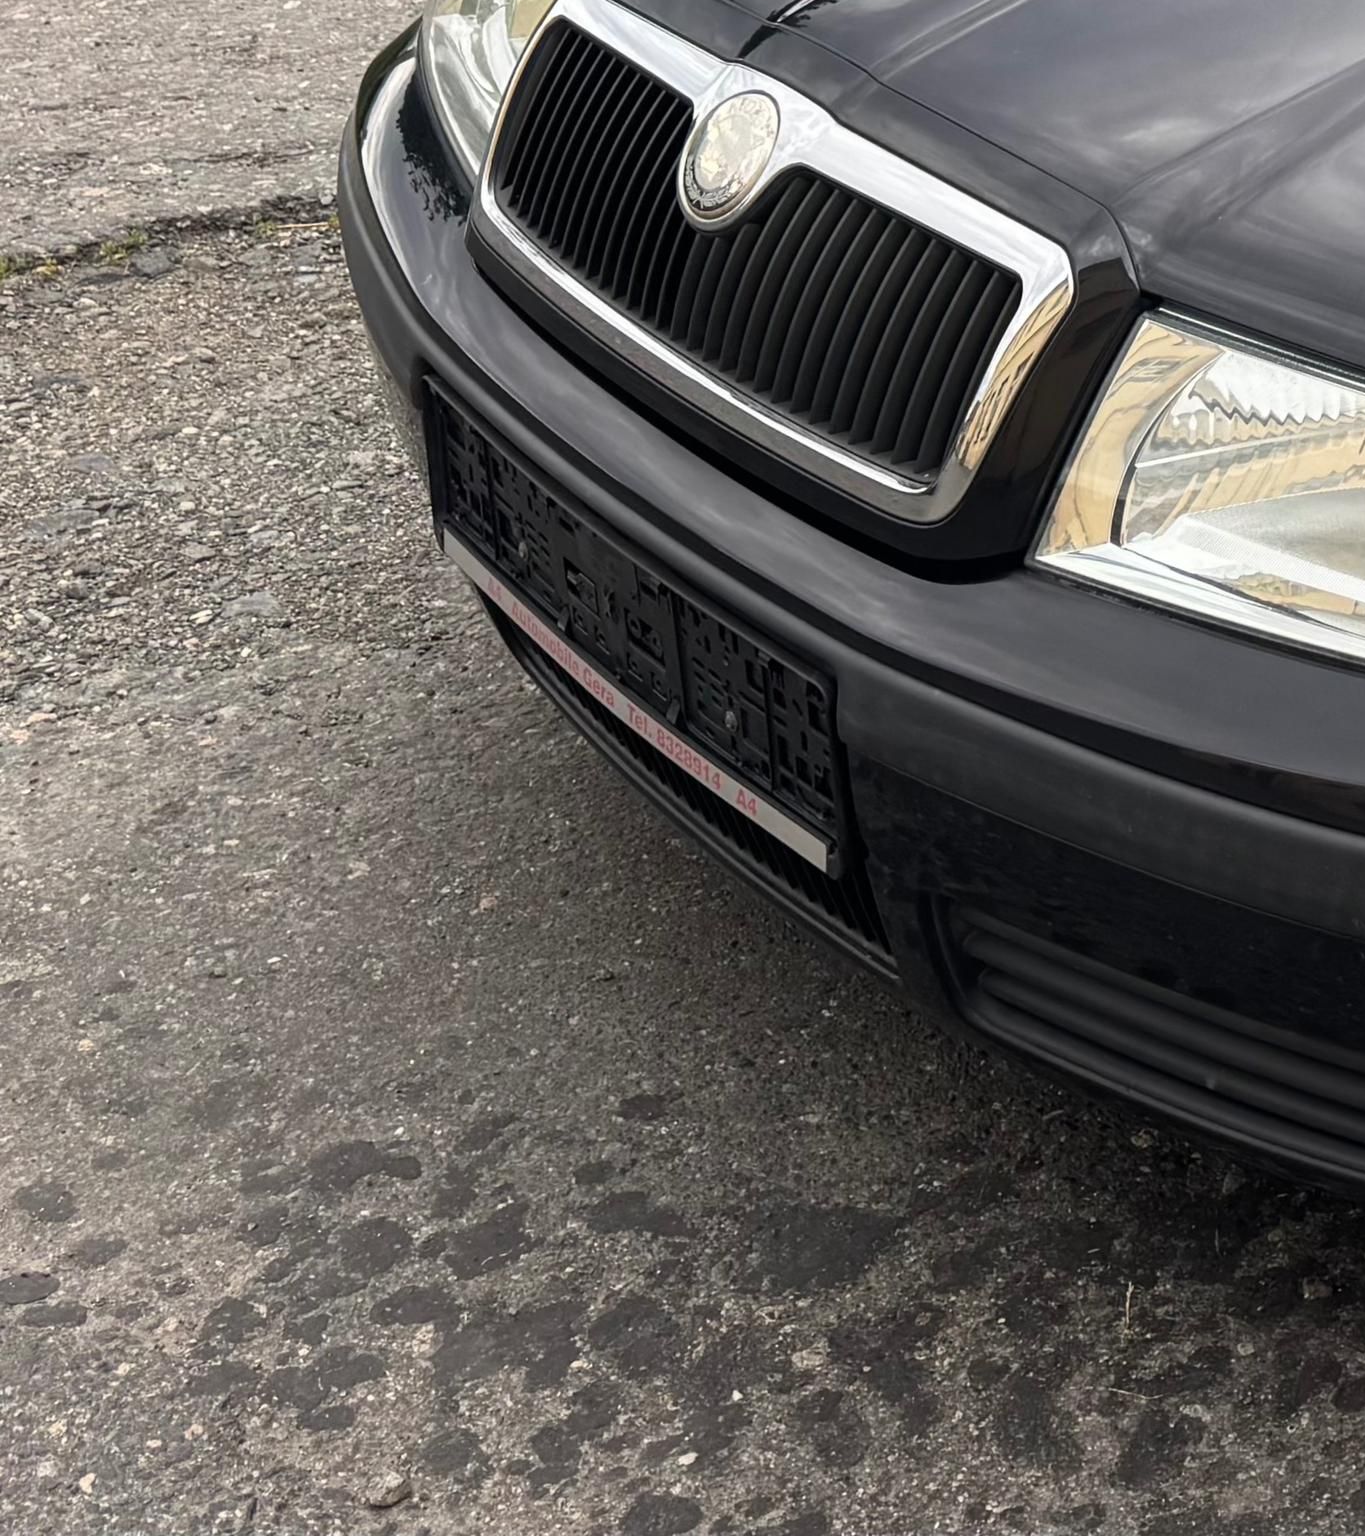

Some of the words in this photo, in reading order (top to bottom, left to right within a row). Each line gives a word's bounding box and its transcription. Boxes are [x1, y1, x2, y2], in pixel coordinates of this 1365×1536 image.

[511, 602, 579, 676] Automobile
[583, 668, 615, 707] Gera
[627, 703, 652, 738] Tel.
[655, 729, 721, 791] 8328914
[736, 788, 758, 817] A4
